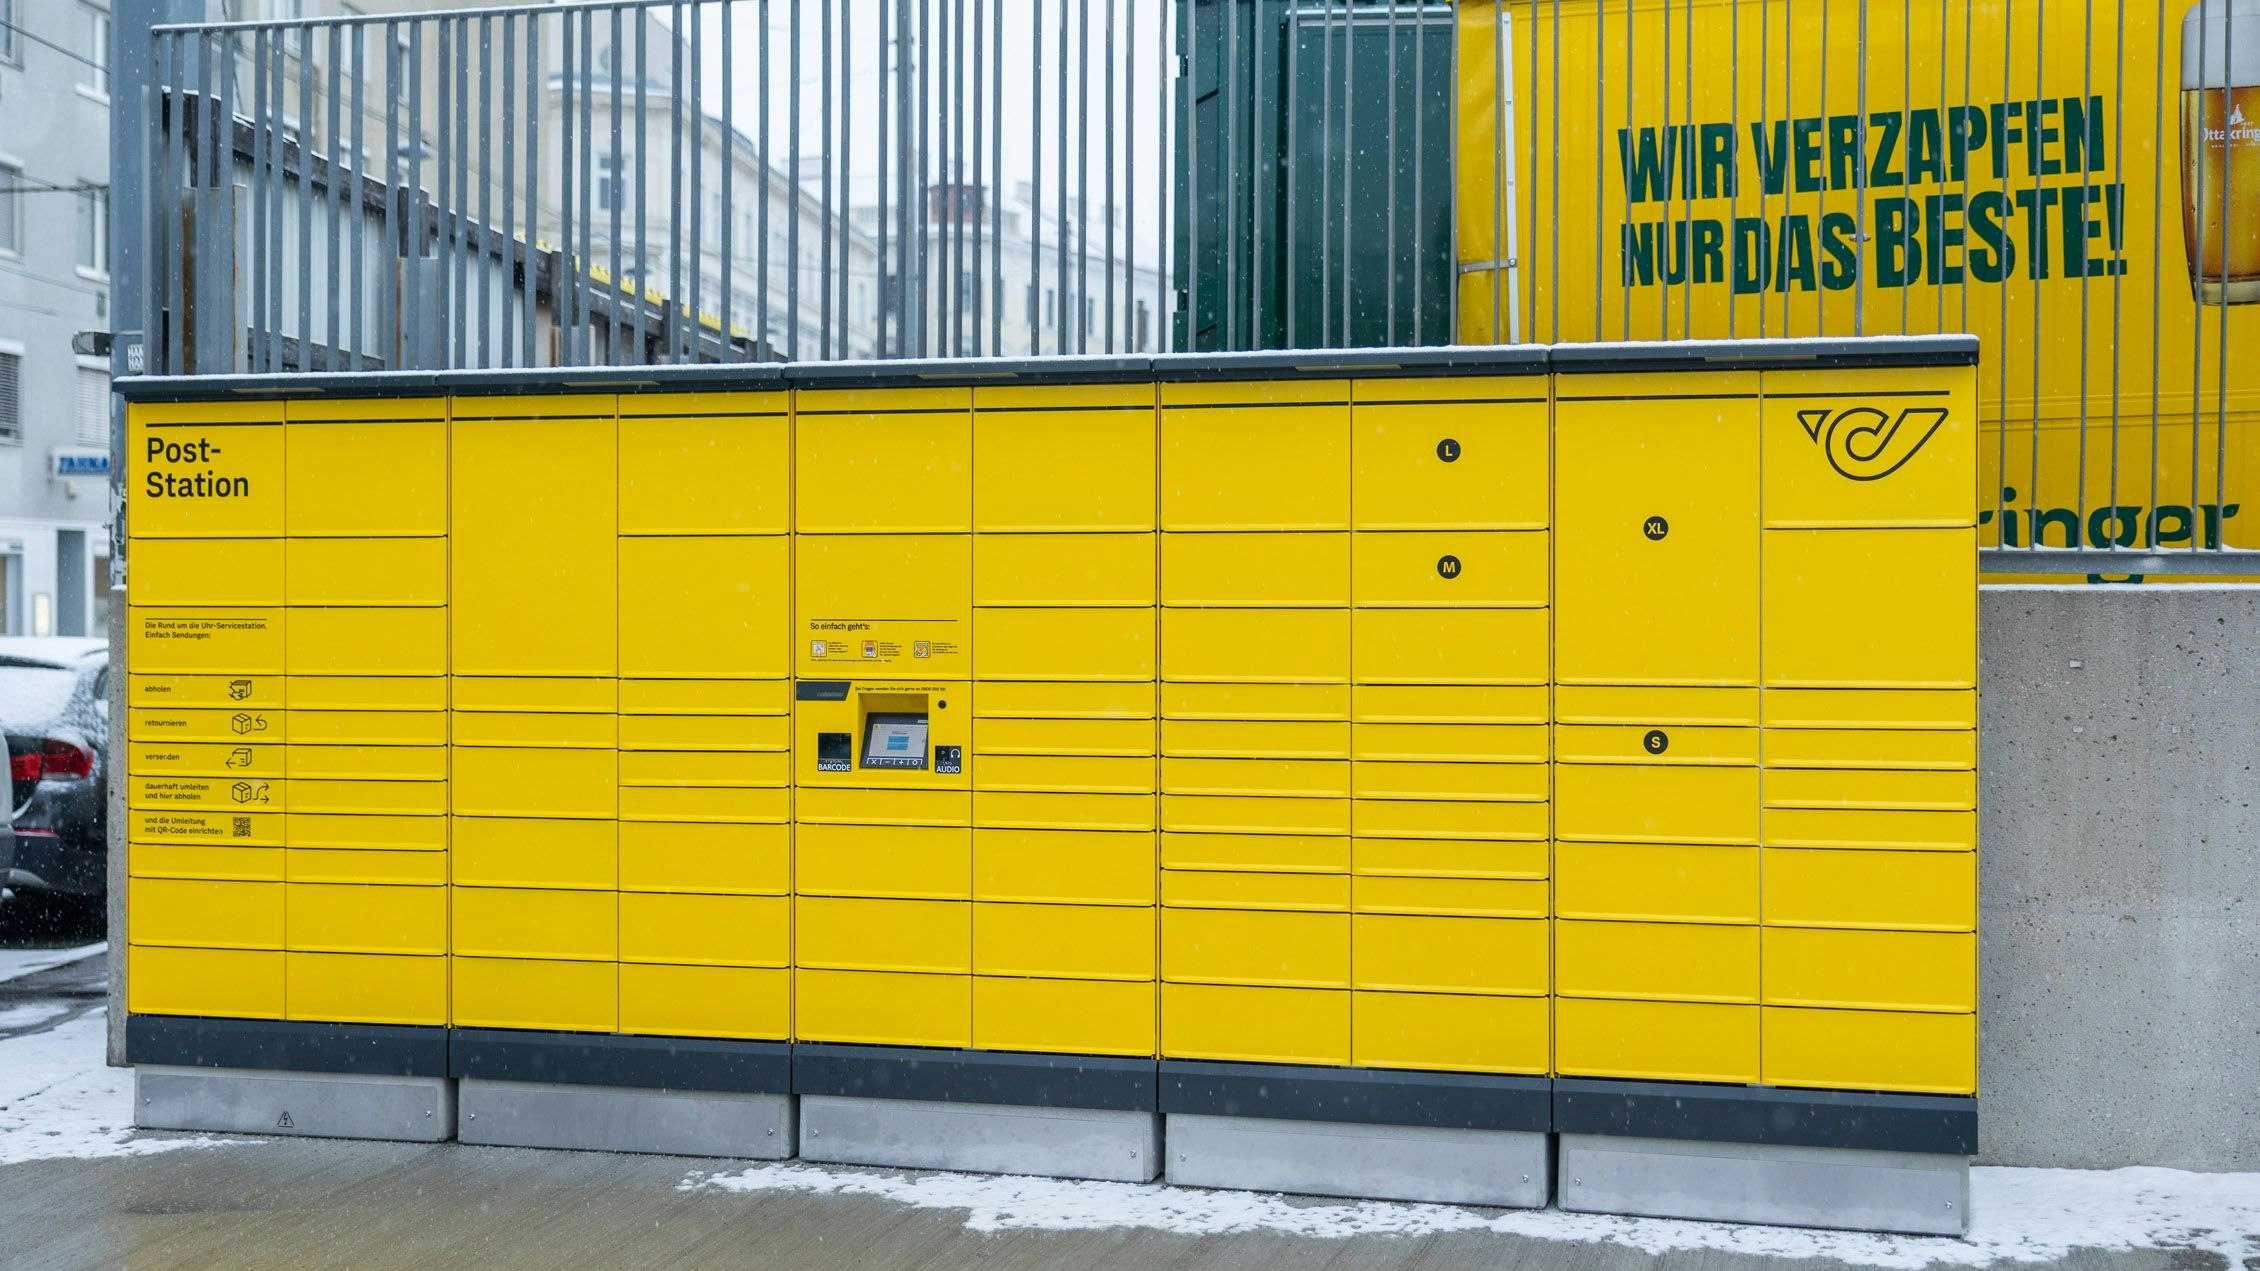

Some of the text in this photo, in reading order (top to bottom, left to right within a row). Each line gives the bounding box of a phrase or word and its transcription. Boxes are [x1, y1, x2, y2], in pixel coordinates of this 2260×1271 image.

[1618, 95, 2105, 203] WIR VERZAPFEN
[1620, 183, 2128, 295] NUR DAS BESTE!
[147, 437, 221, 464] Post-
[145, 469, 249, 498] Station
[1979, 486, 2240, 584] inger
[145, 621, 156, 629] Die
[158, 621, 175, 629] Rund
[810, 622, 820, 630] So
[821, 622, 846, 630] einfach
[145, 631, 211, 640] Einfach Sendungen:
[145, 685, 172, 693] abholen
[145, 719, 187, 727] retournieren
[818, 763, 851, 771] BARCODE
[936, 765, 960, 773] AUDIO
[145, 782, 210, 791] dauerhaft umleiten
[159, 792, 173, 800] hier
[174, 792, 201, 801] abholen
[159, 816, 170, 824] die
[171, 817, 206, 826] Umleitung
[157, 826, 188, 835] QR-Code
[188, 827, 223, 835] einrichten
